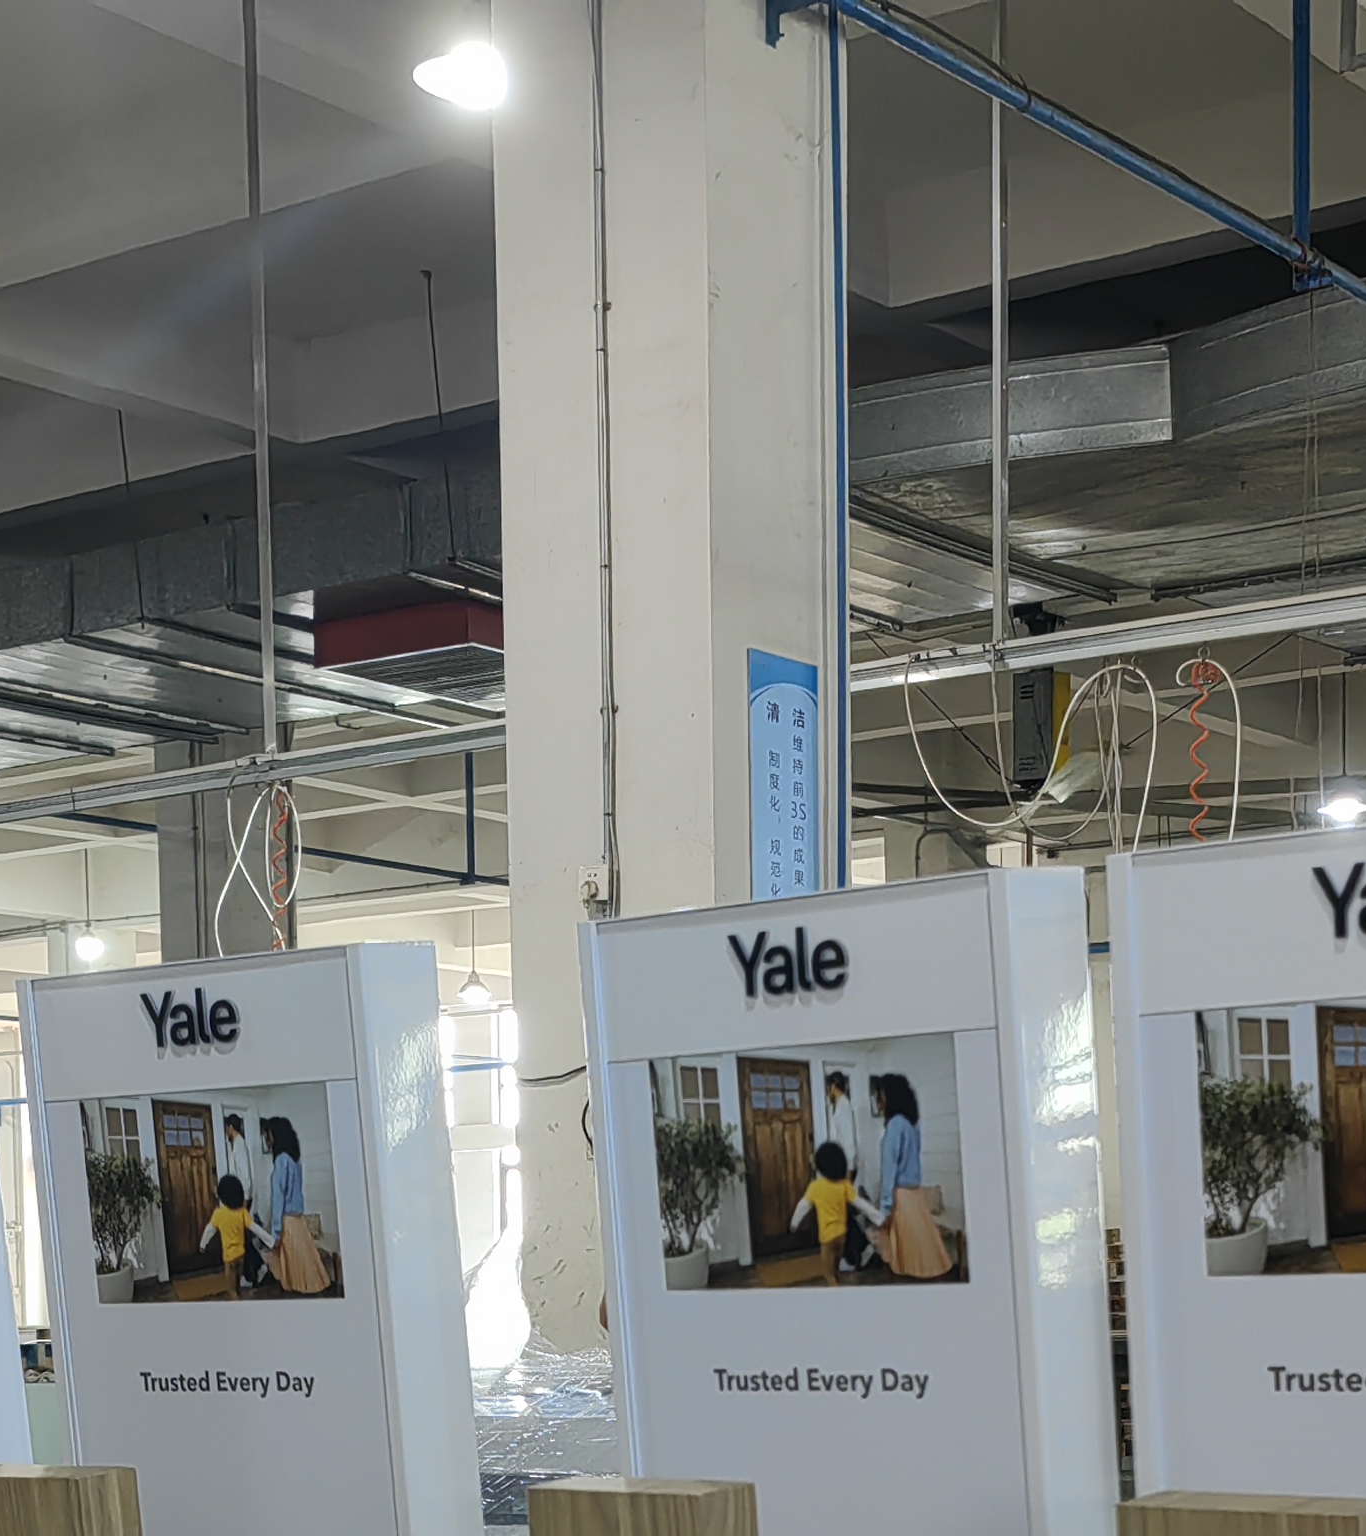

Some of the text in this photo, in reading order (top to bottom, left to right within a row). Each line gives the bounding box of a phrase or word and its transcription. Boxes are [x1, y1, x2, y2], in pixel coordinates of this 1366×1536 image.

[727, 926, 848, 998] Yale
[139, 987, 239, 1048] Yale
[139, 1369, 315, 1399] Trusted Every Day
[713, 1366, 929, 1400] Trusted Every Day
